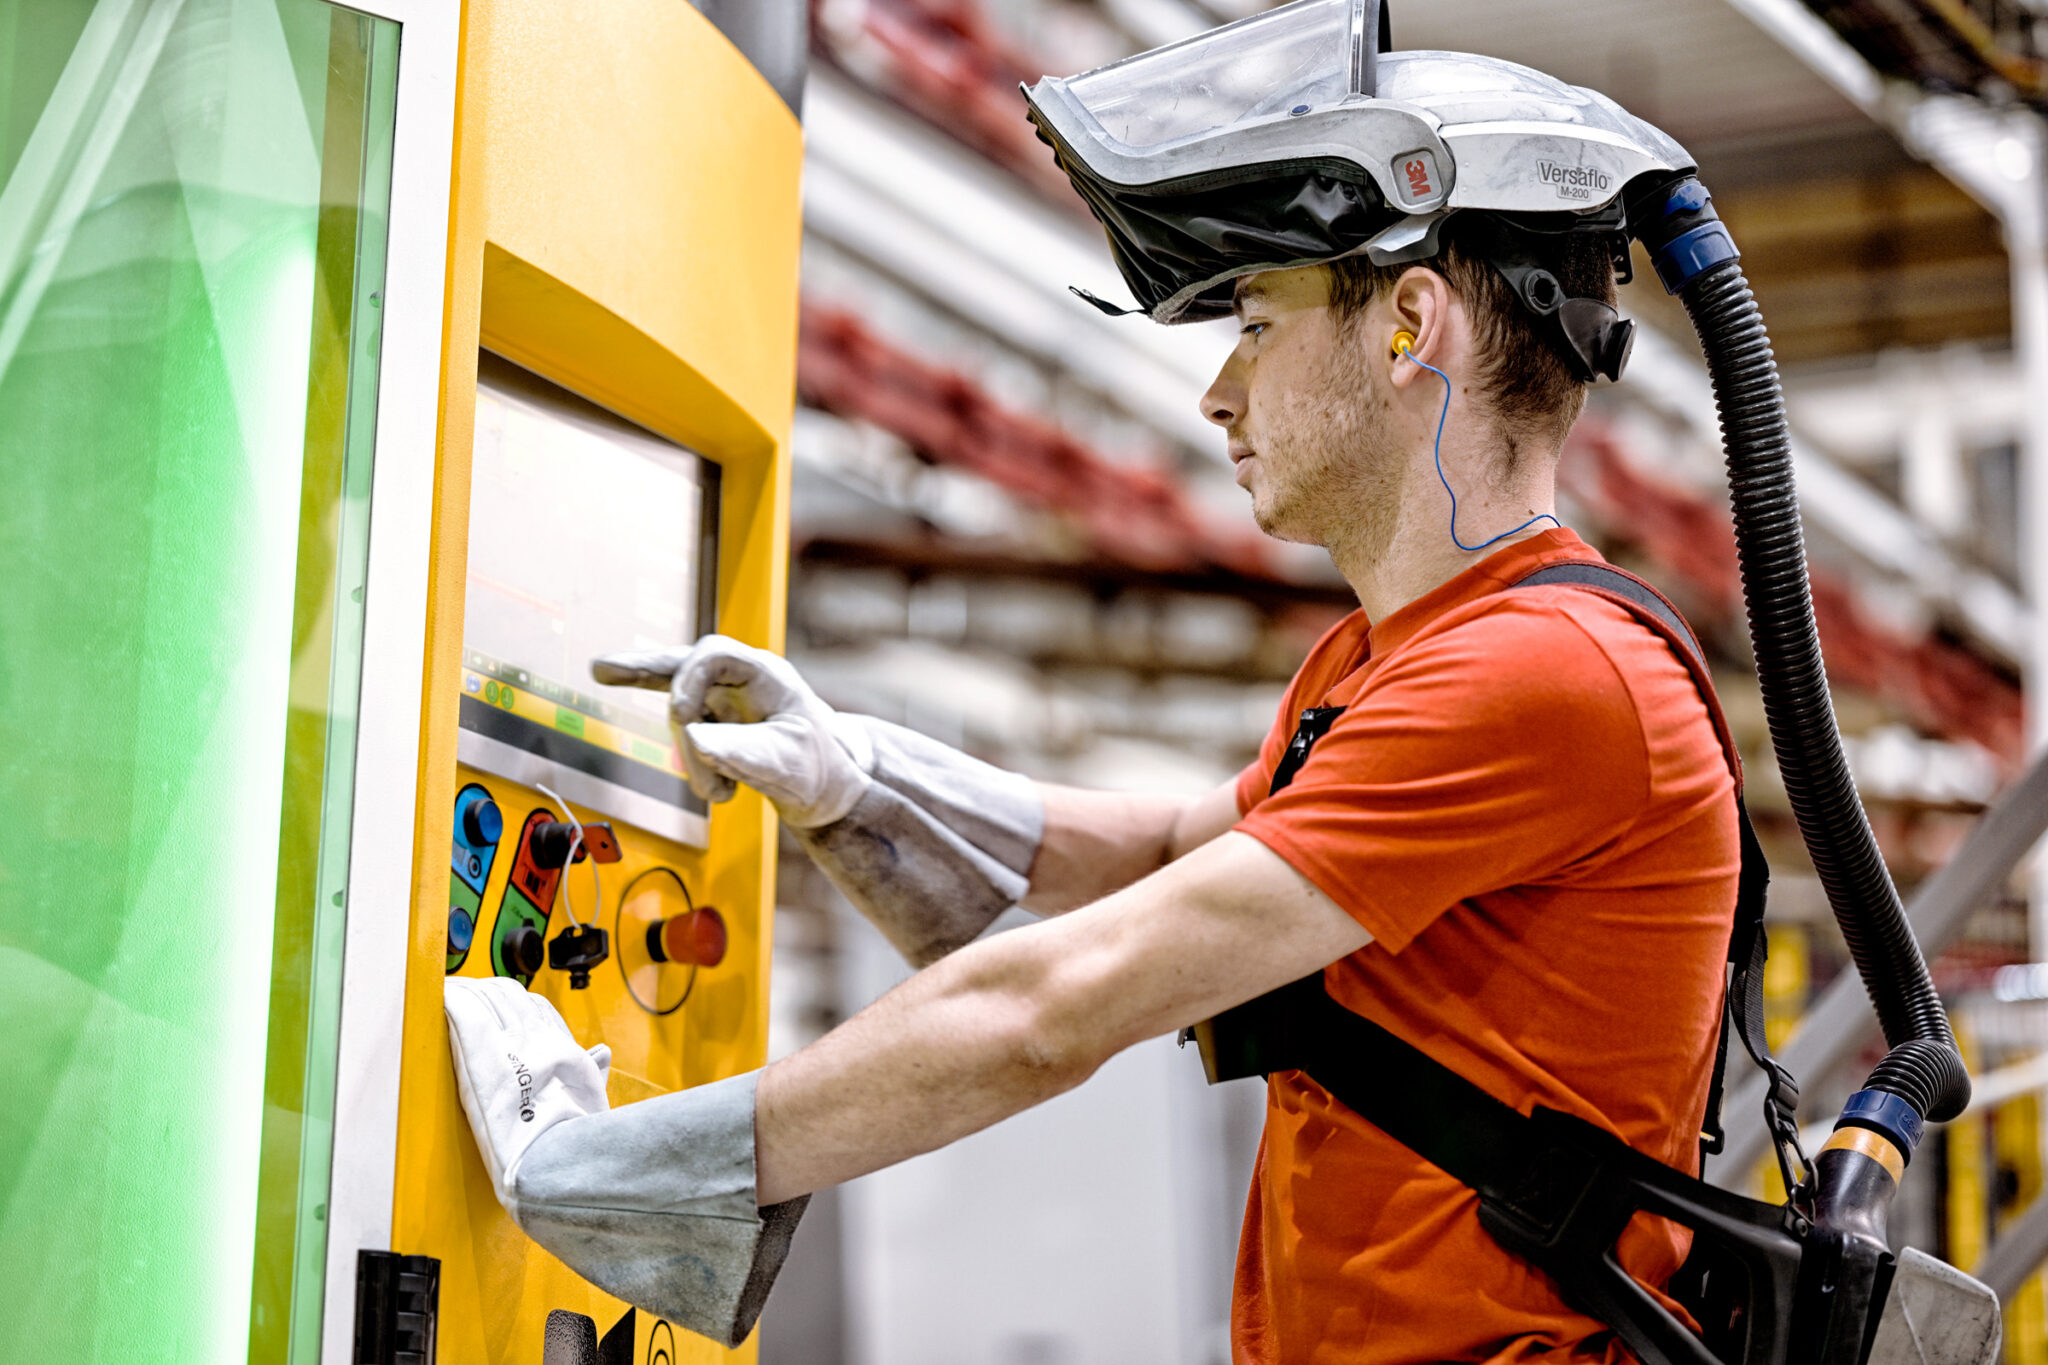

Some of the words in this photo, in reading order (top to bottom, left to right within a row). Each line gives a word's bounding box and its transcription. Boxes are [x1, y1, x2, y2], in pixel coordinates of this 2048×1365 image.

[1405, 159, 1431, 197] 3M
[1540, 162, 1608, 190] Versaflo
[1561, 186, 1589, 199] M-200
